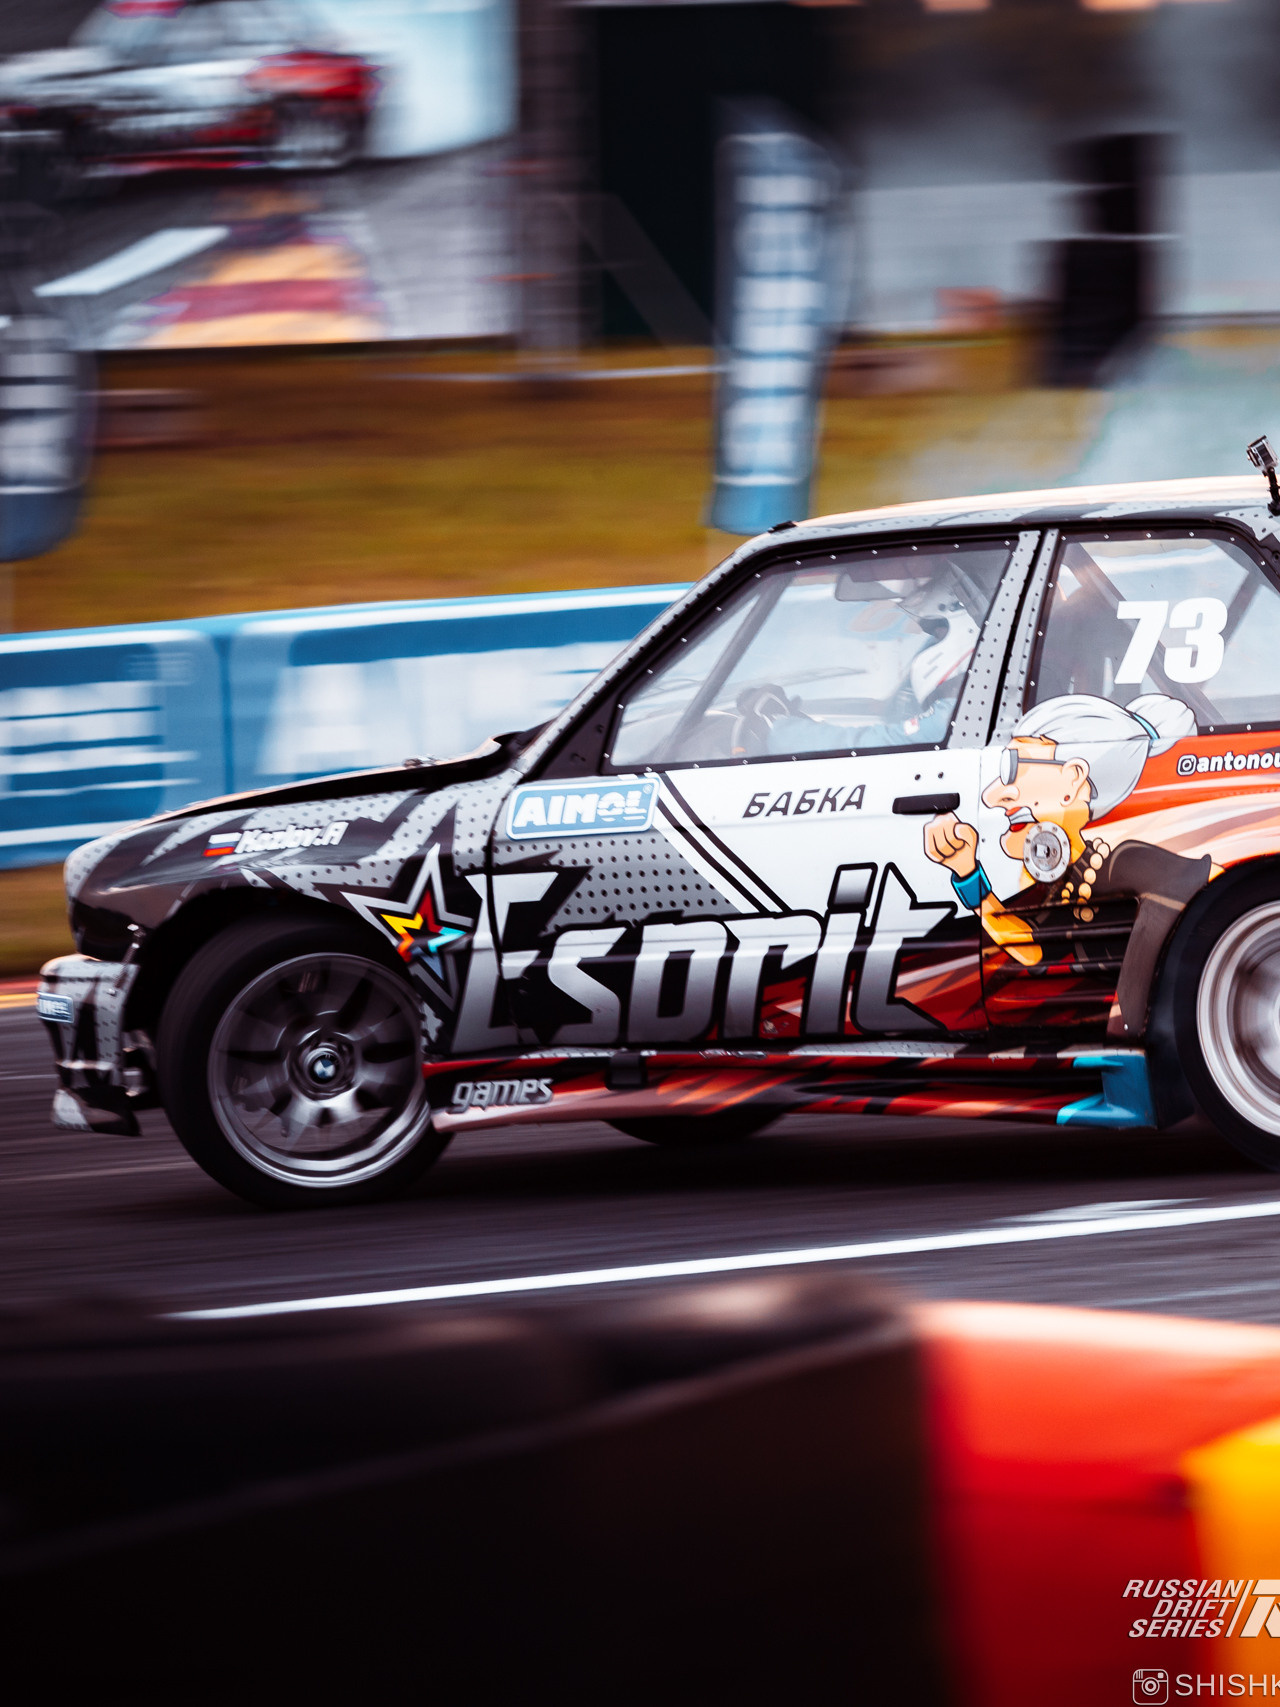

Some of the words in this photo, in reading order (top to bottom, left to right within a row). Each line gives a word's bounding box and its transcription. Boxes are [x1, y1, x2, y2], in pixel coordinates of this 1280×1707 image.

[1114, 596, 1228, 685] 73
[512, 789, 648, 828] AIMOL
[742, 784, 867, 819] БАБКА
[445, 1078, 554, 1115] games
